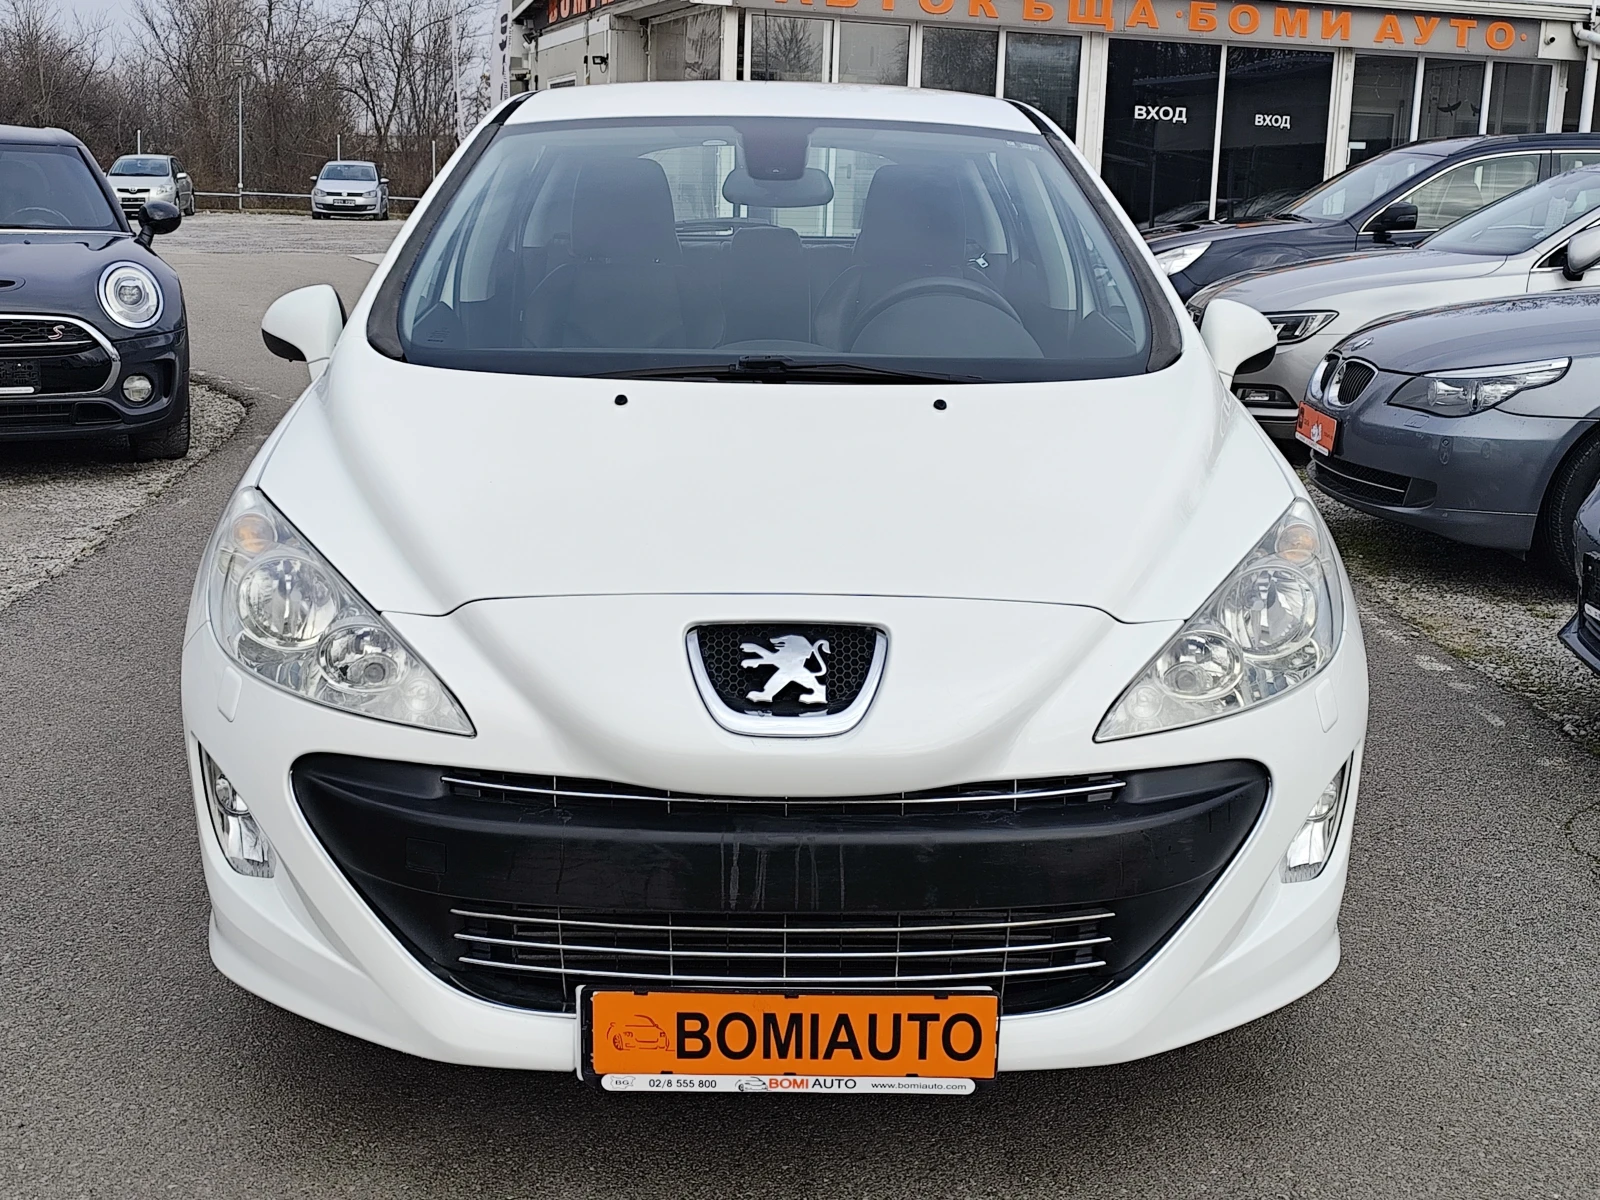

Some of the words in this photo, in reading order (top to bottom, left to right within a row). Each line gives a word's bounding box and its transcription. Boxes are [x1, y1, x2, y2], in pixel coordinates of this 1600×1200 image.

[1188, 1, 1352, 41] БОМИ
[1373, 14, 1516, 51] АУТО
[1134, 105, 1187, 123] ВХОД
[1254, 114, 1291, 129] ВХОД
[676, 1011, 983, 1062] BOMIAUTO
[648, 1079, 673, 1089] 02/8
[676, 1080, 695, 1088] 555
[698, 1080, 717, 1088] 800
[769, 1078, 809, 1090] BOMI
[812, 1078, 858, 1090] AUTO
[870, 1081, 967, 1091] www.bomiauto.com
